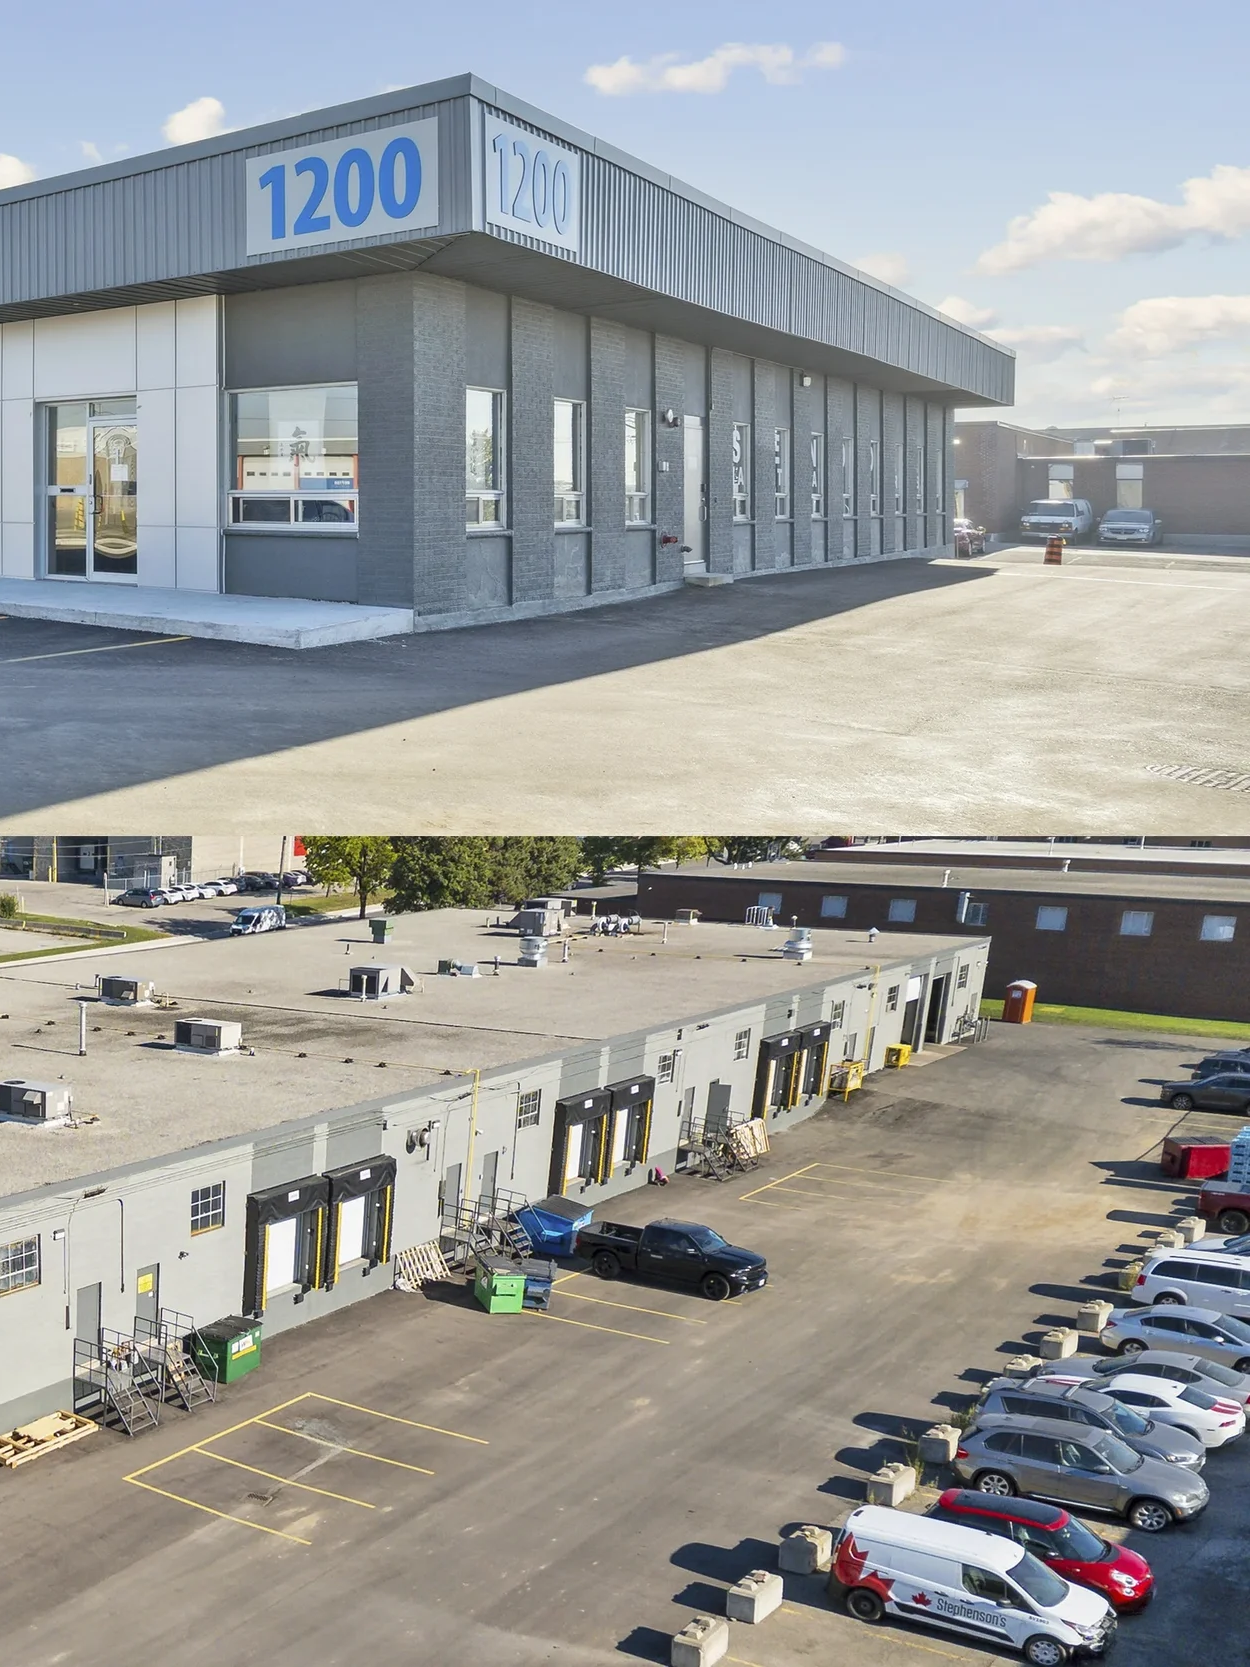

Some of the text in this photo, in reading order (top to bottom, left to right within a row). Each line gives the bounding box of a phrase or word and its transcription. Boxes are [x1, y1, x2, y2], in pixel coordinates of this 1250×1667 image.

[259, 137, 422, 240] 1200
[493, 132, 572, 236] 1200
[937, 1598, 1007, 1628] Stephenson's
